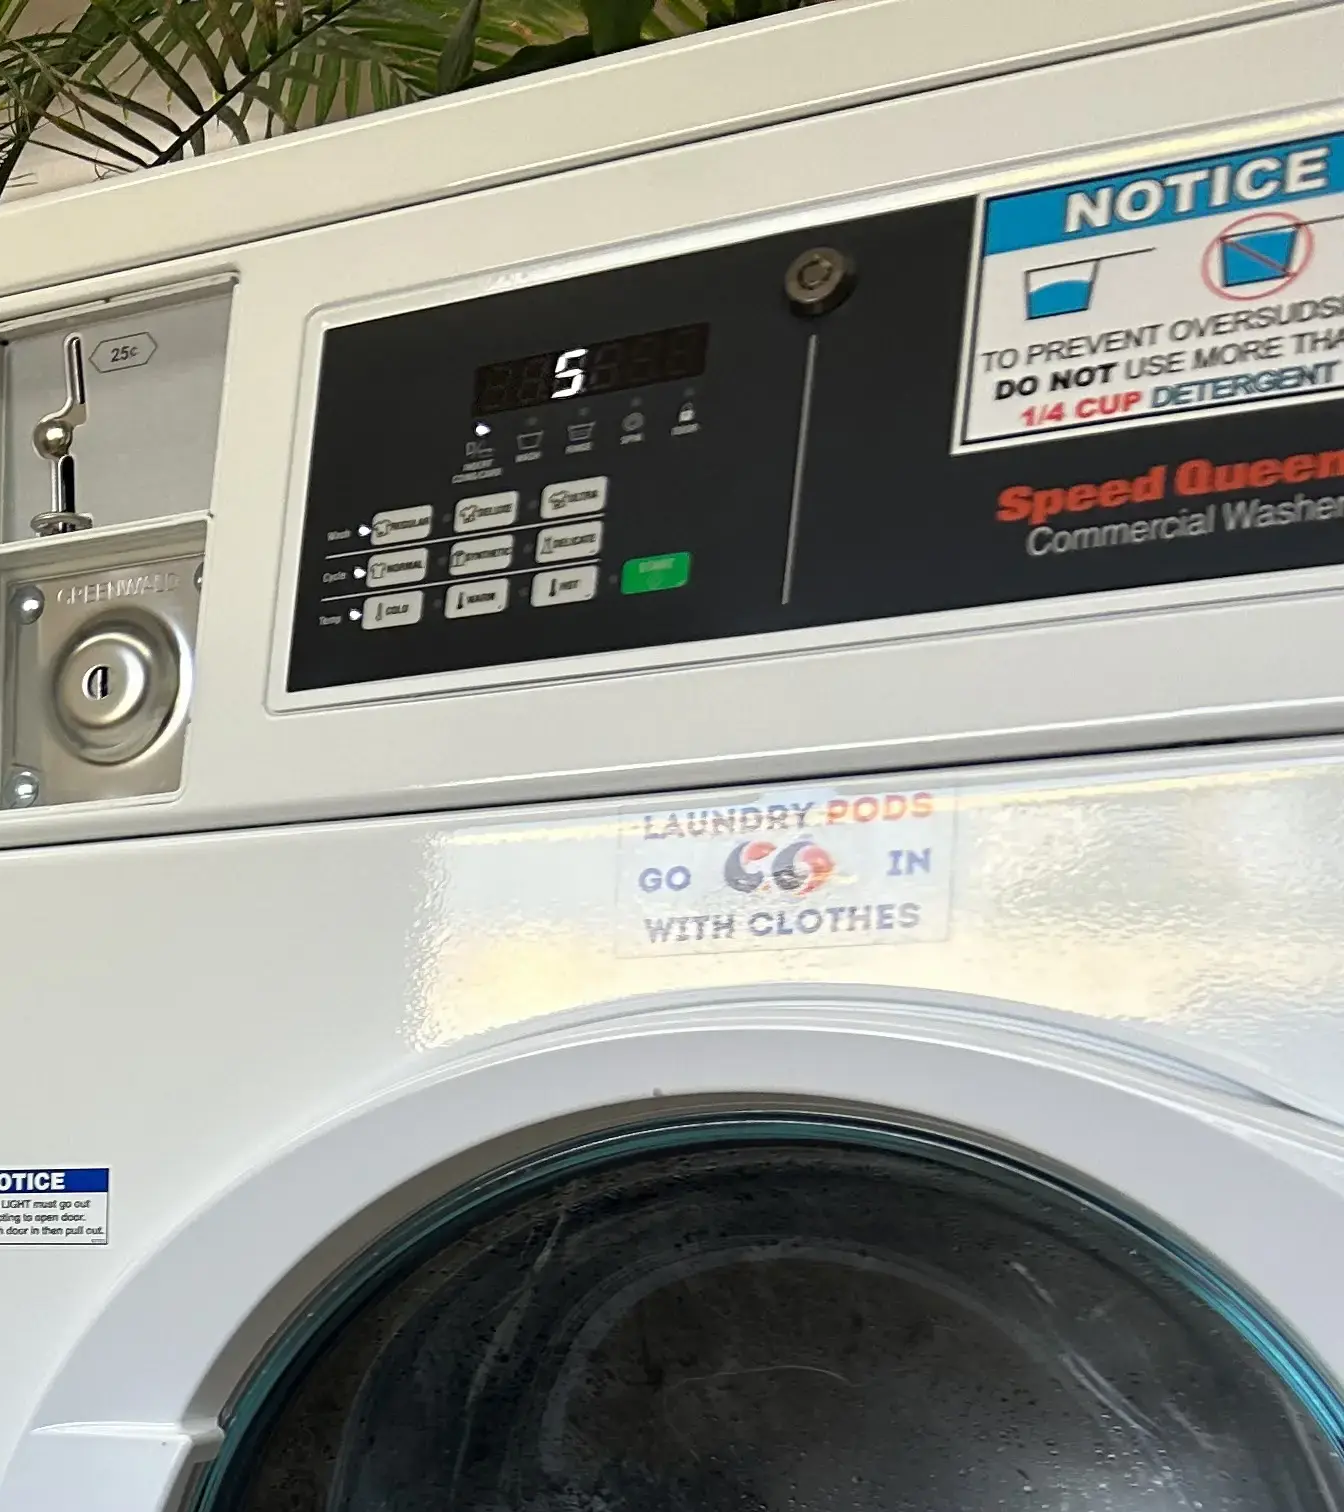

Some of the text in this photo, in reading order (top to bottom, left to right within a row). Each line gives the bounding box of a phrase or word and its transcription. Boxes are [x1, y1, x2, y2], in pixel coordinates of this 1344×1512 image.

[1065, 147, 1330, 233] NOTICE
[981, 348, 1019, 372] TO
[1026, 323, 1164, 365] PREVENT
[994, 375, 1038, 401] DO
[1050, 361, 1120, 392] NOT
[1125, 350, 1186, 380] USE
[1192, 336, 1285, 369] MORE
[550, 348, 589, 399] 5
[1020, 359, 1342, 427] 1/4 CUP DETERGENT
[995, 449, 1344, 525] Speed Queen
[1025, 492, 1344, 556] Commercial Washer
[643, 792, 935, 840] LAUNDRY PODS
[638, 848, 932, 893] GO IN
[643, 903, 922, 943] WITH CLOTHES
[1, 1199, 32, 1209] LIGHT
[33, 1200, 57, 1208] must
[59, 1201, 72, 1210] go
[74, 1200, 91, 1208] out
[23, 1213, 33, 1221] to
[34, 1215, 58, 1223] open
[6, 1226, 29, 1235] door
[31, 1226, 39, 1235] in
[41, 1226, 63, 1235] then
